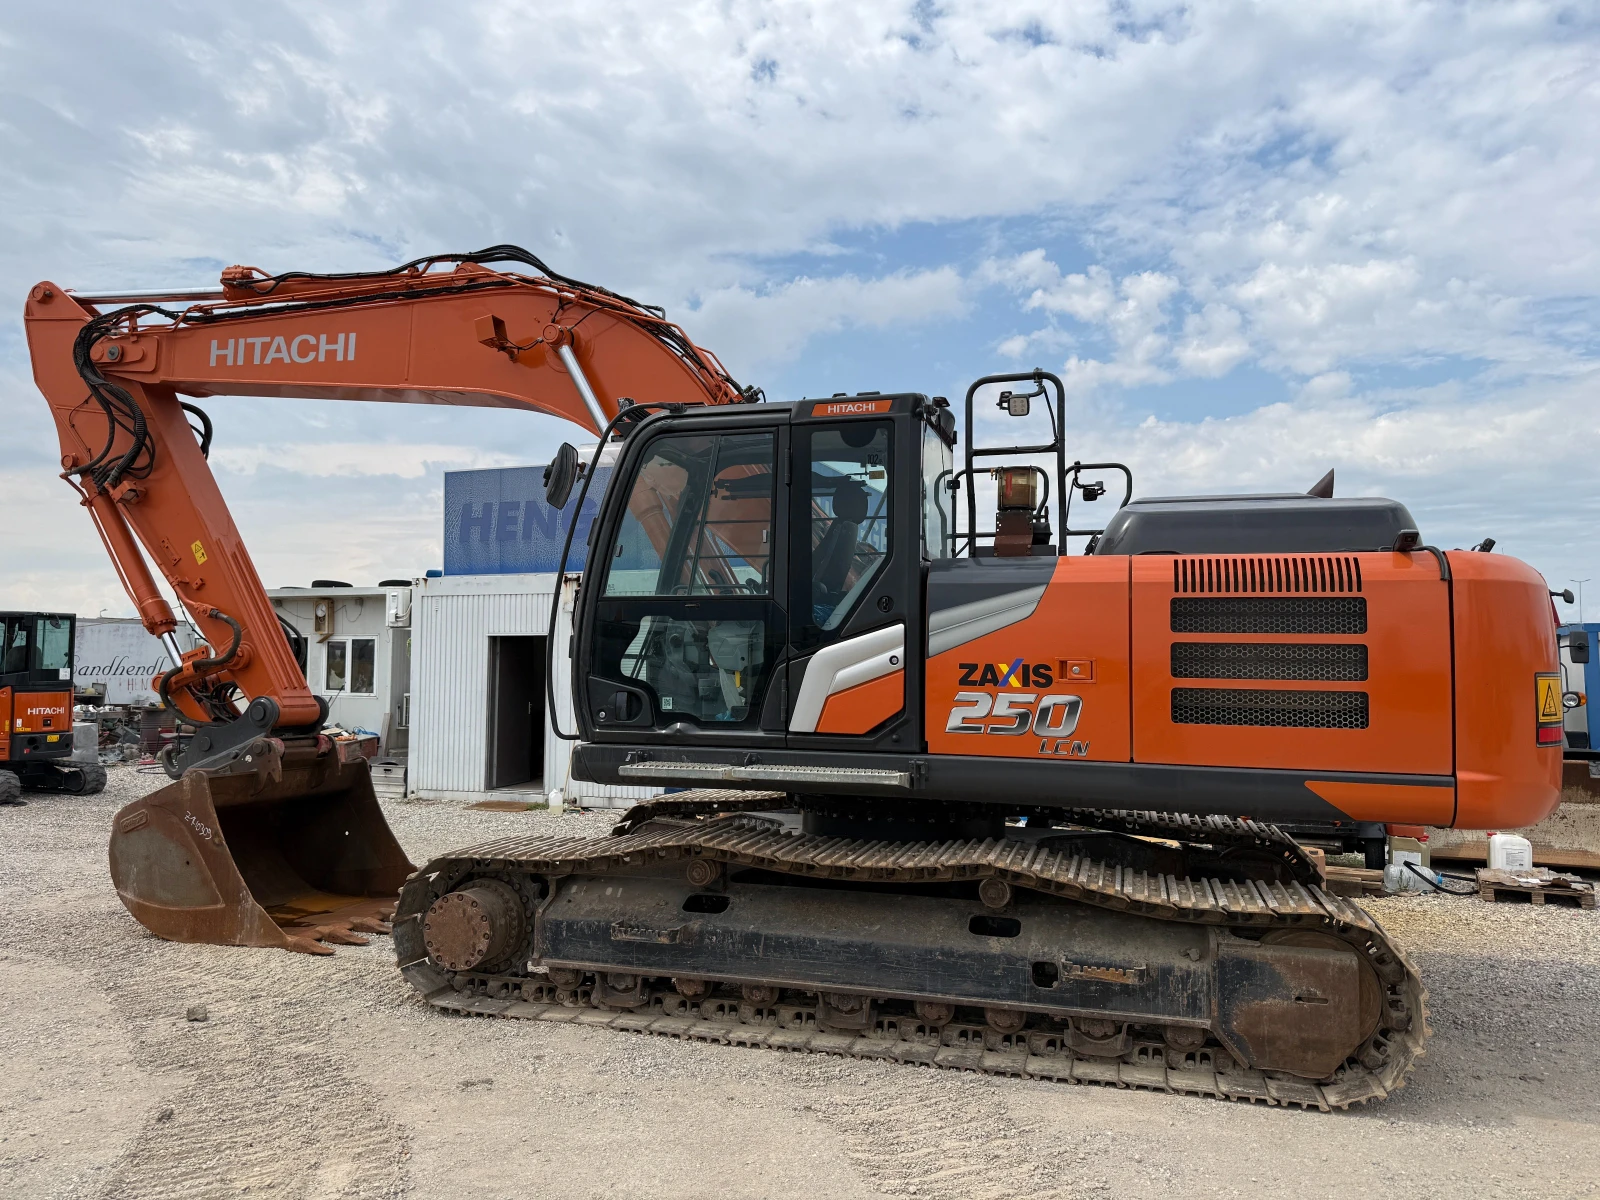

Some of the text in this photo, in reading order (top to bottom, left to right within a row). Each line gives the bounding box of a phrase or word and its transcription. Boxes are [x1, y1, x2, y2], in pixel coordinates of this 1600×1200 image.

[209, 332, 357, 367] HITACHI
[827, 402, 876, 414] HITACHI
[958, 658, 1054, 689] ZAXIS
[27, 706, 65, 715] HITACHI
[944, 690, 1084, 738] 250
[1038, 738, 1090, 757] LCN
